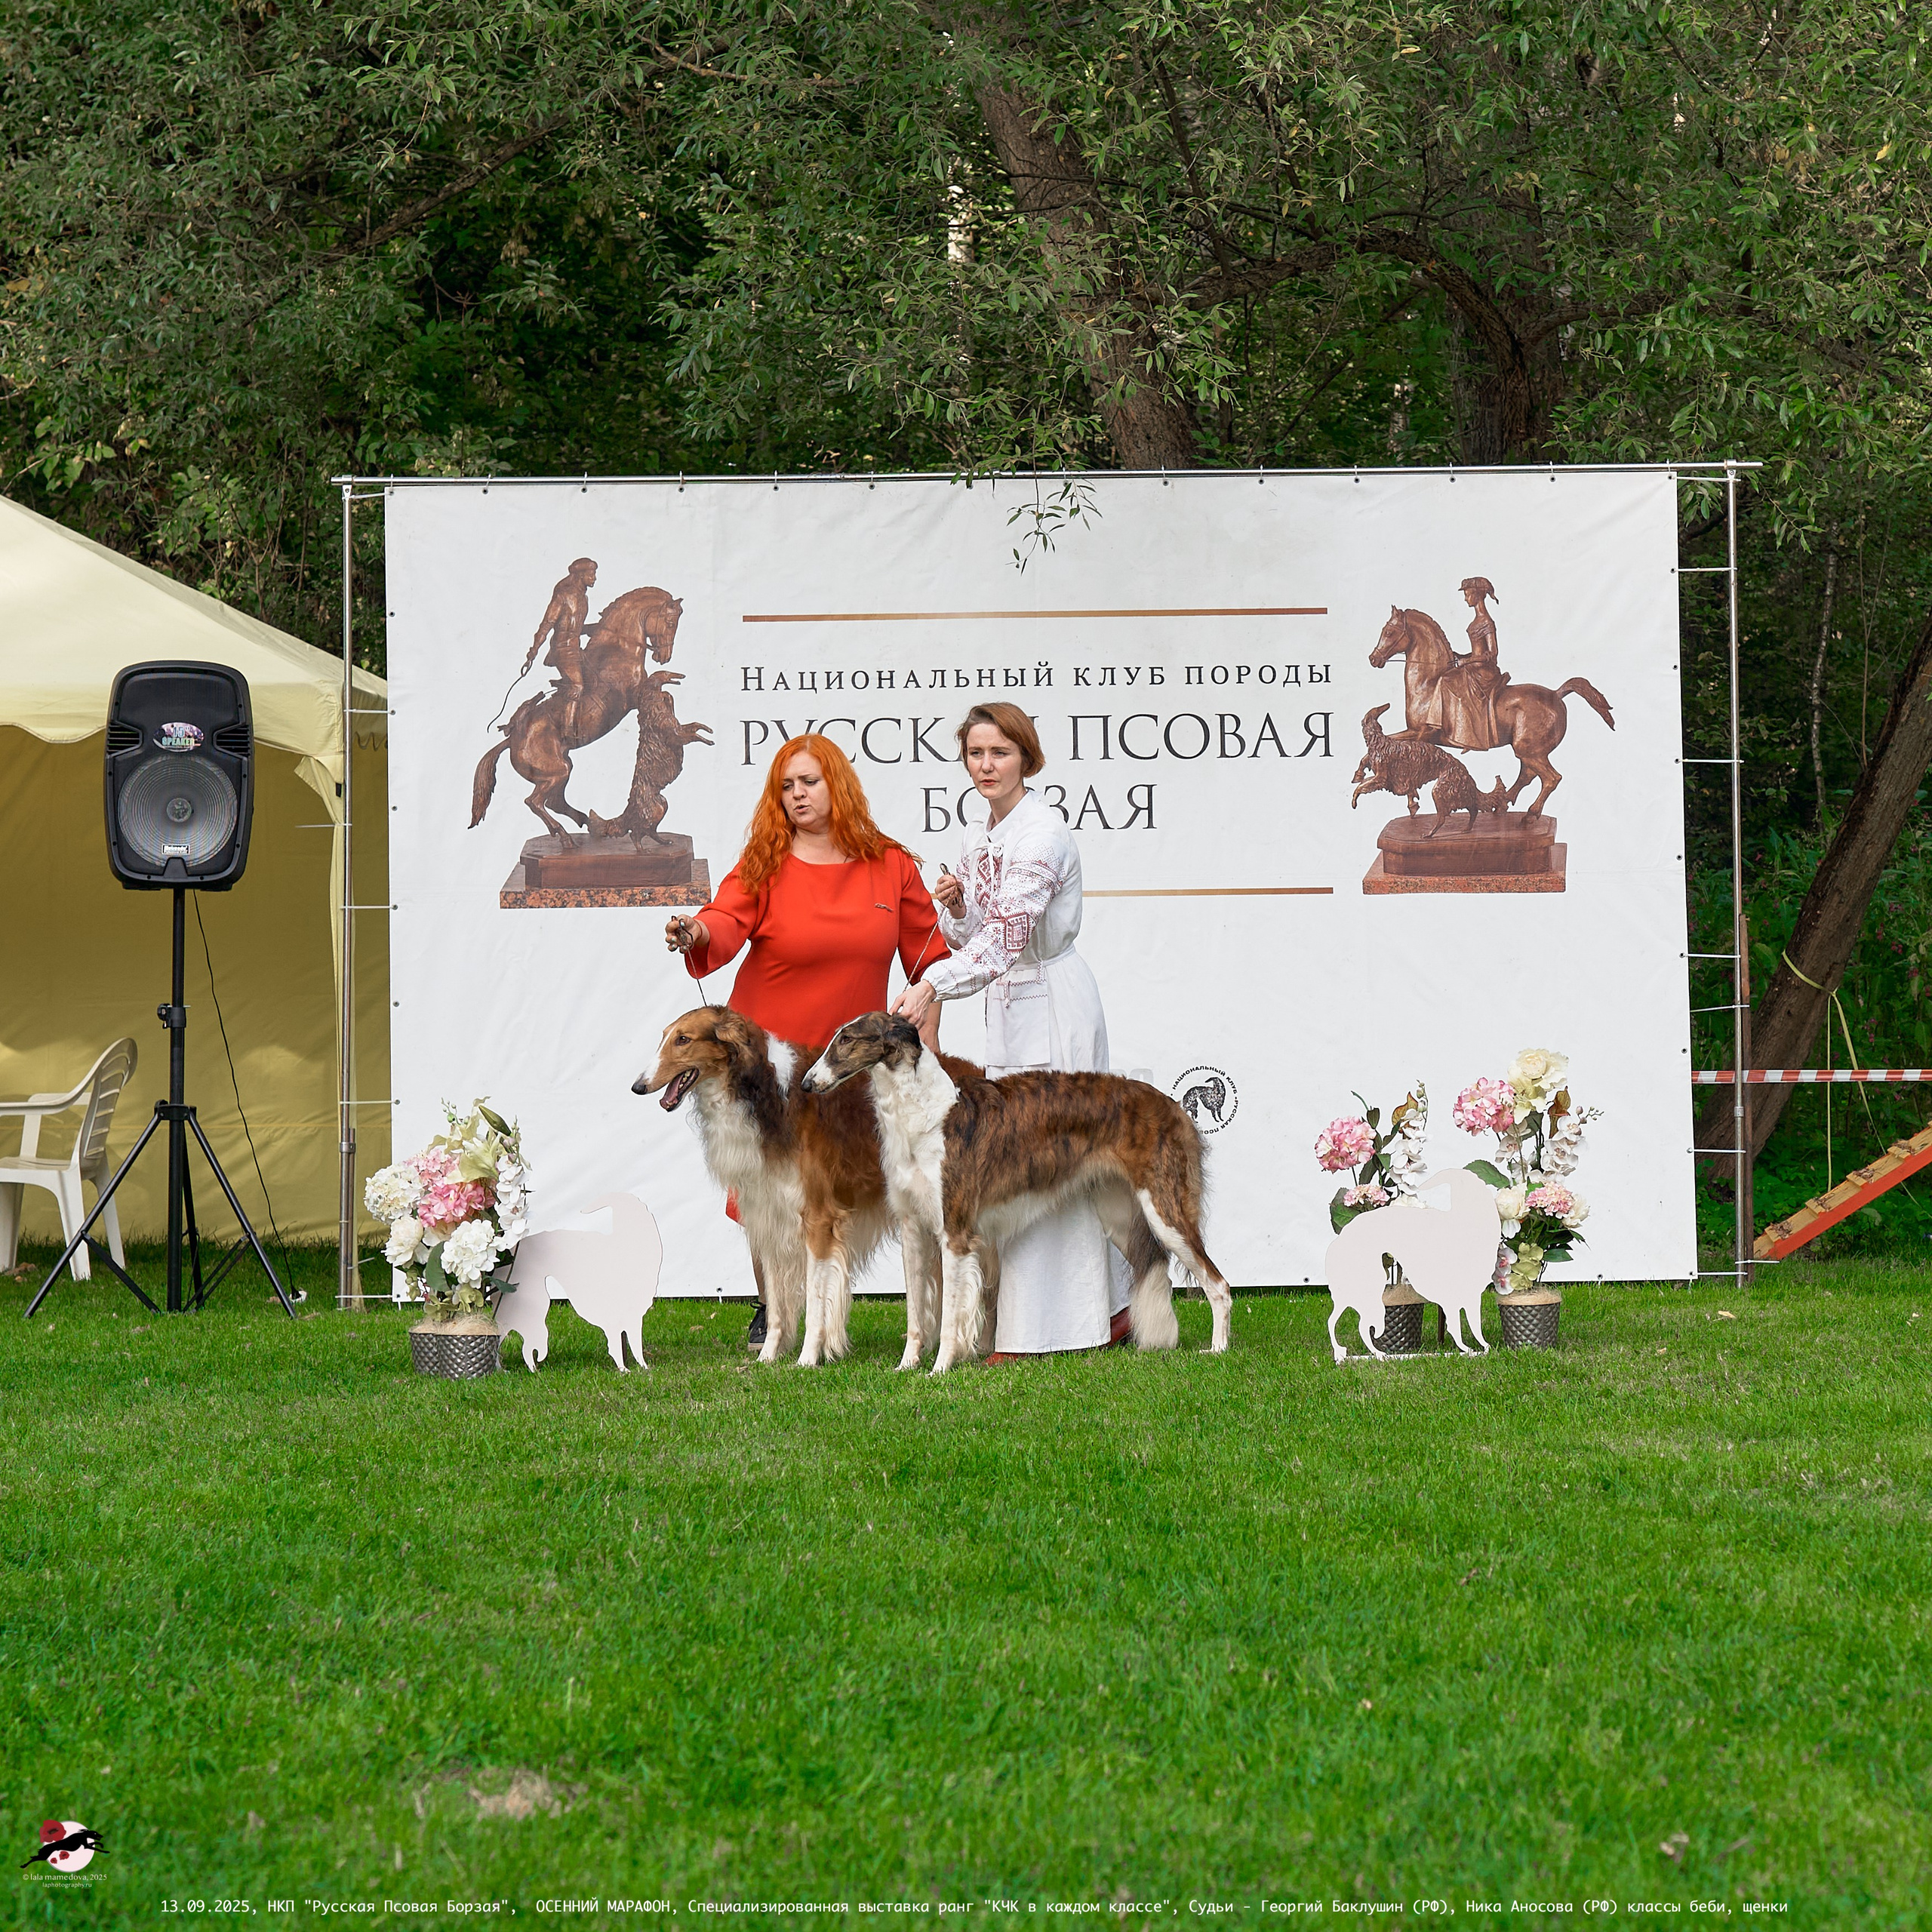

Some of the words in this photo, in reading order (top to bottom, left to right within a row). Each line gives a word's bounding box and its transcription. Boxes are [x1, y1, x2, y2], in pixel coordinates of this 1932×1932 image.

[740, 715, 1038, 765] РУССК
[1067, 711, 1334, 761] ПСОВАЯ
[1172, 1066, 1226, 1090] НАЦИОНАЛЬНЫЙ
[1226, 1076, 1238, 1094] КЛУБ
